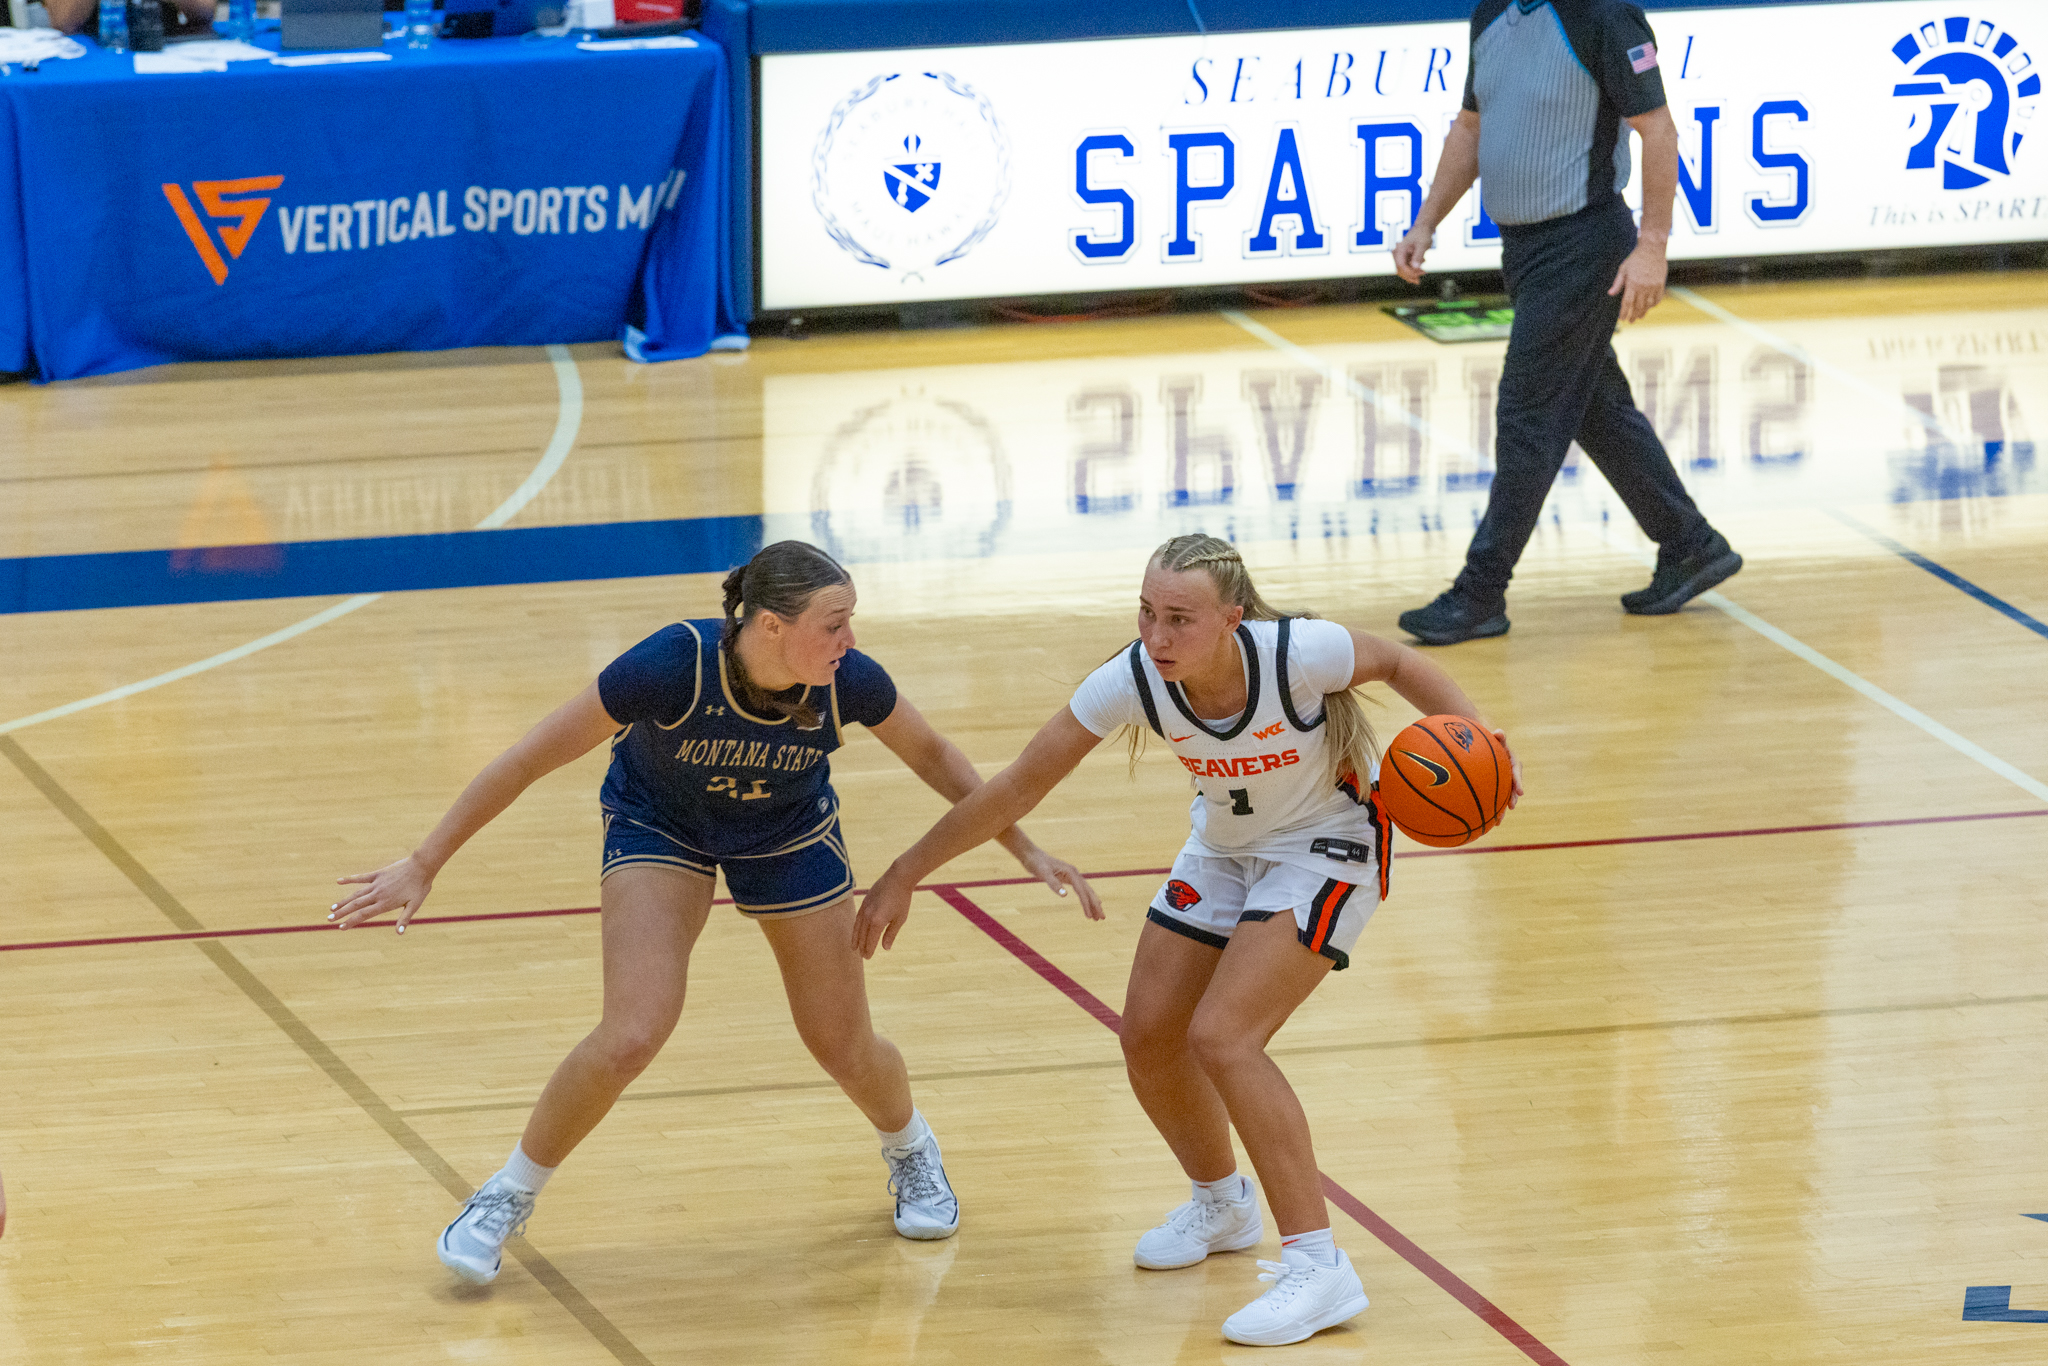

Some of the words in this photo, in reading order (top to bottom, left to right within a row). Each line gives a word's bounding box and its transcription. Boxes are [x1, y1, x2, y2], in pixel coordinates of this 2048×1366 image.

[1184, 46, 1453, 105] SEABUR
[1068, 93, 1814, 264] SPARNS
[278, 189, 457, 254] VERTICAL
[462, 184, 609, 234] SPORTS
[1954, 196, 2048, 223] SPART
[1252, 721, 1286, 741] WCC
[675, 739, 770, 768] MONTANA
[1178, 748, 1300, 778] BEAVERS
[1228, 788, 1254, 816] 1
